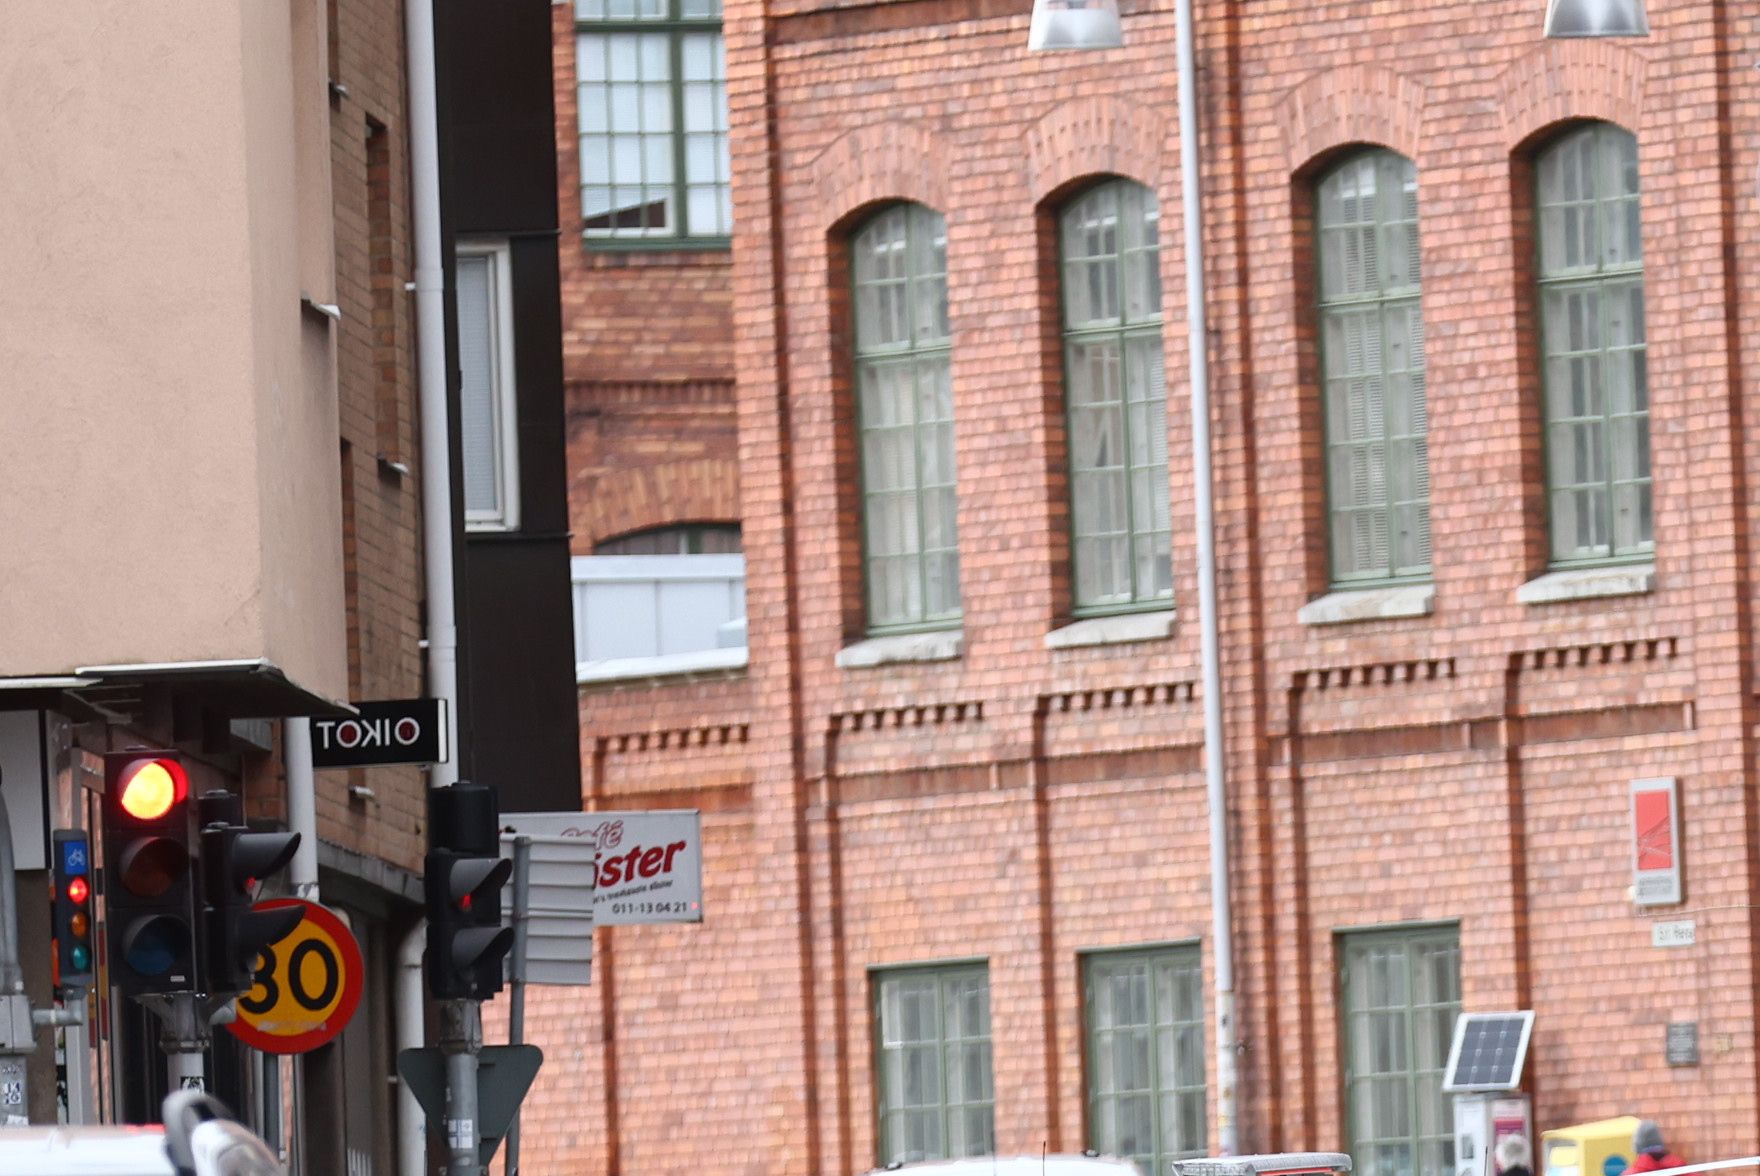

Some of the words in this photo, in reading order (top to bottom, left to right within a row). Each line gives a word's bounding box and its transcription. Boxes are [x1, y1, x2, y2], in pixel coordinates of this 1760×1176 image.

[316, 717, 420, 749] TOKIO
[673, 901, 687, 912] 21
[239, 938, 339, 1012] 30
